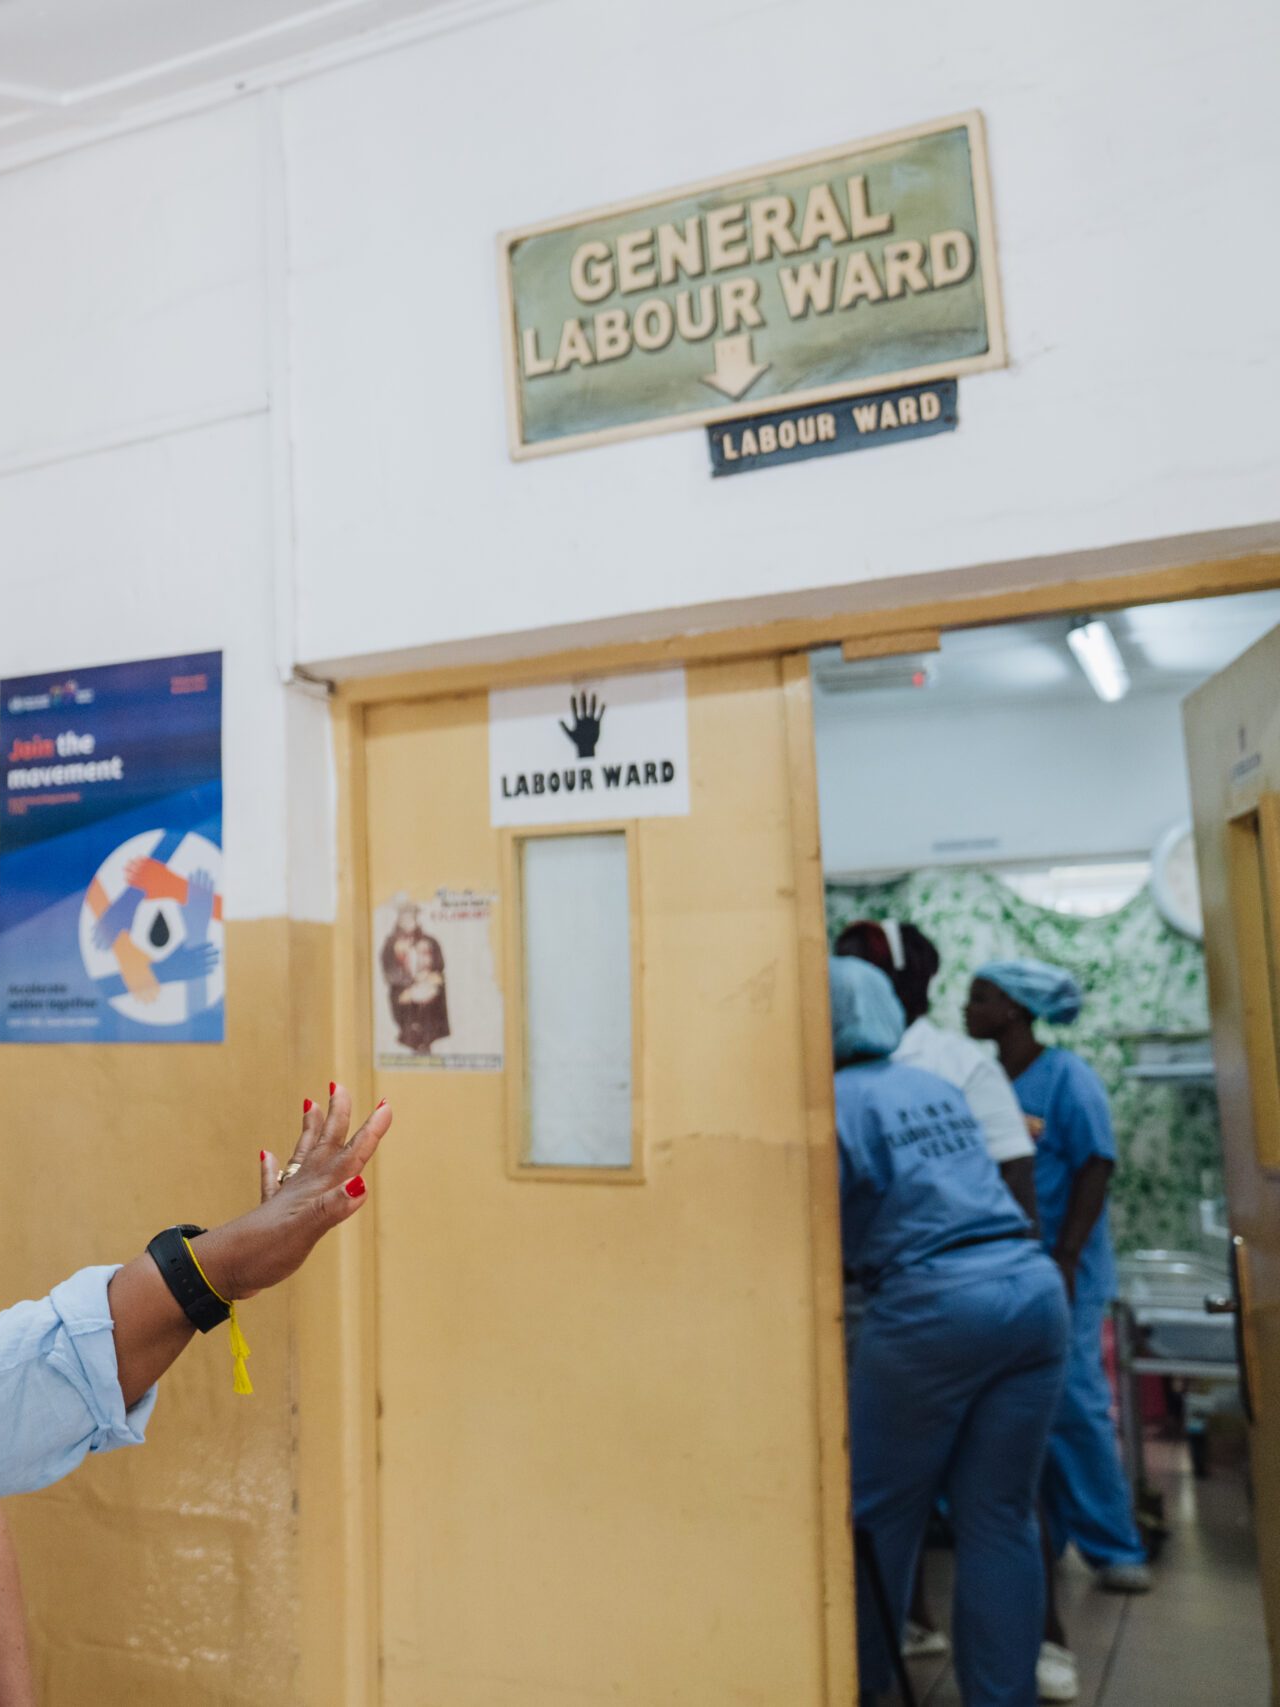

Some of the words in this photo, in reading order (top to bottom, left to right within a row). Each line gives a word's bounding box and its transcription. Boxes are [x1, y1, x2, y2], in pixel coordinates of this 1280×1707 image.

[570, 174, 893, 304] GENERAL
[523, 277, 764, 379] LABOUR
[779, 229, 976, 320] WARD
[722, 412, 836, 461] LABOUR
[852, 392, 942, 434] WARD
[7, 755, 124, 790] movement
[8, 734, 55, 763] Join
[56, 730, 95, 757] the
[501, 768, 594, 799] LABOUR
[602, 760, 675, 789] WARD
